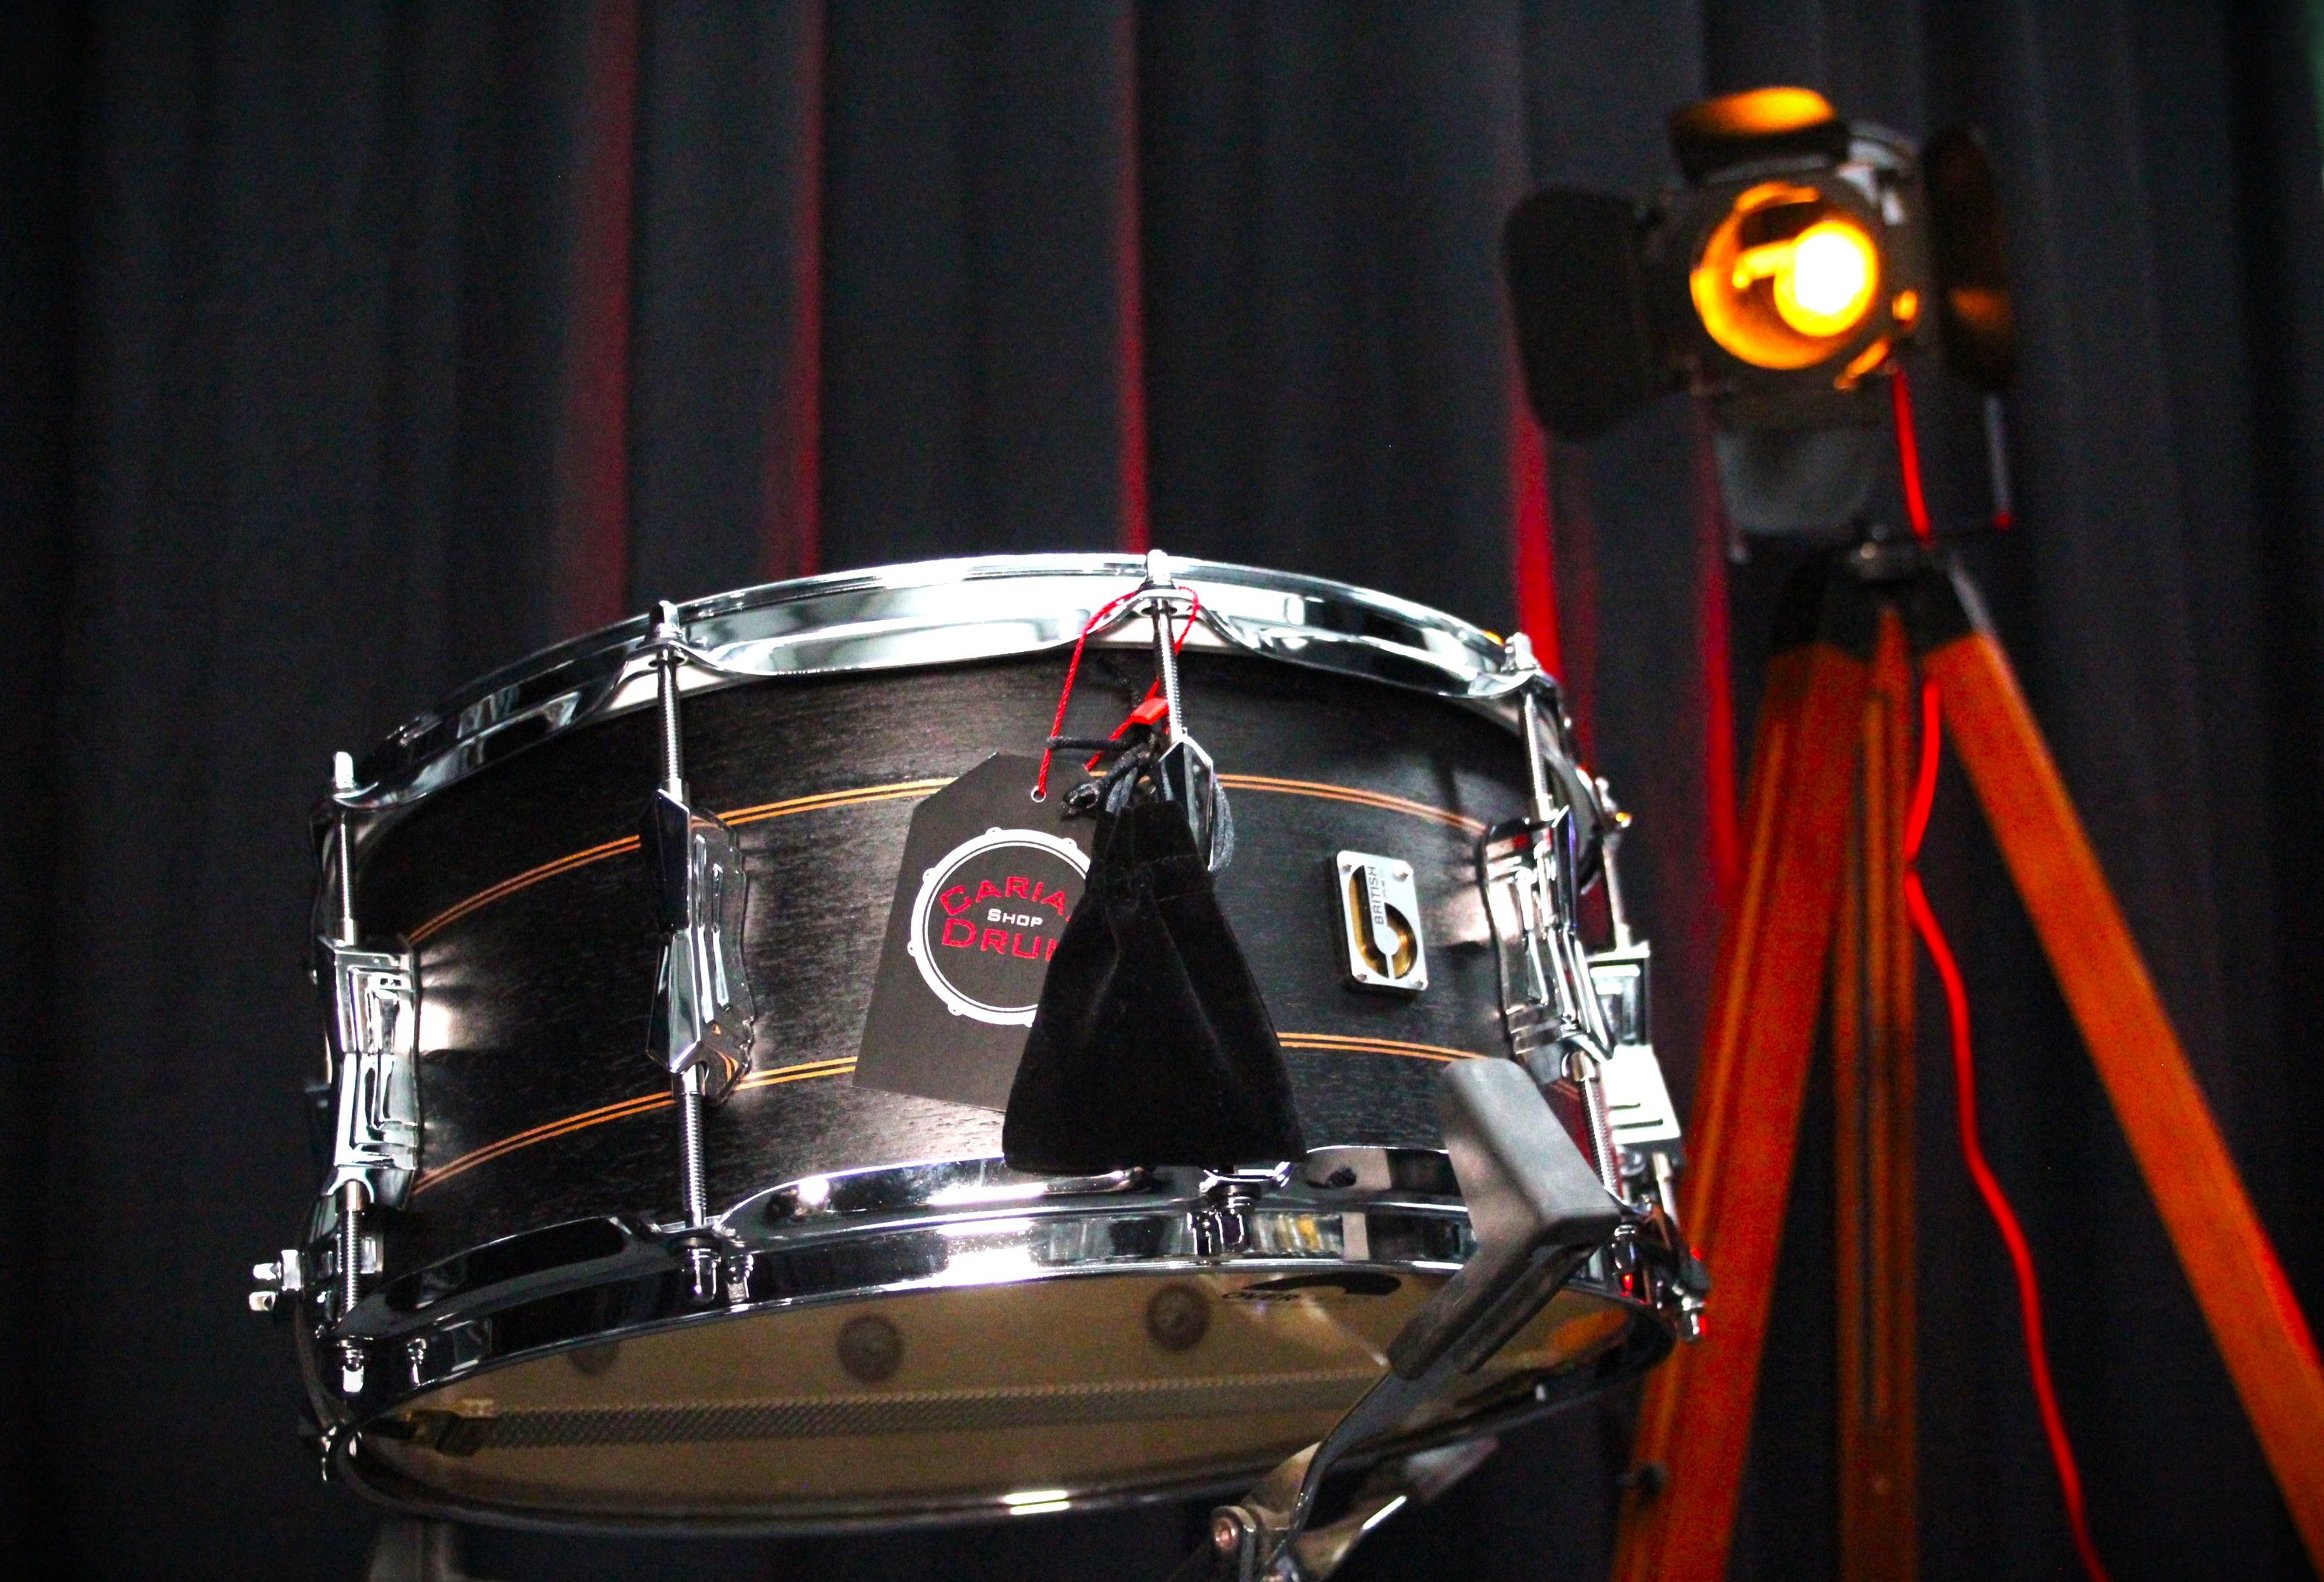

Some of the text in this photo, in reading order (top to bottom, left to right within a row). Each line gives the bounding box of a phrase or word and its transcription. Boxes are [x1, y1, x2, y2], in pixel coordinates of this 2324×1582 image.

[939, 876, 1071, 921] CARIA
[987, 908, 1043, 927] SHOP
[1367, 867, 1385, 925] BRITISH
